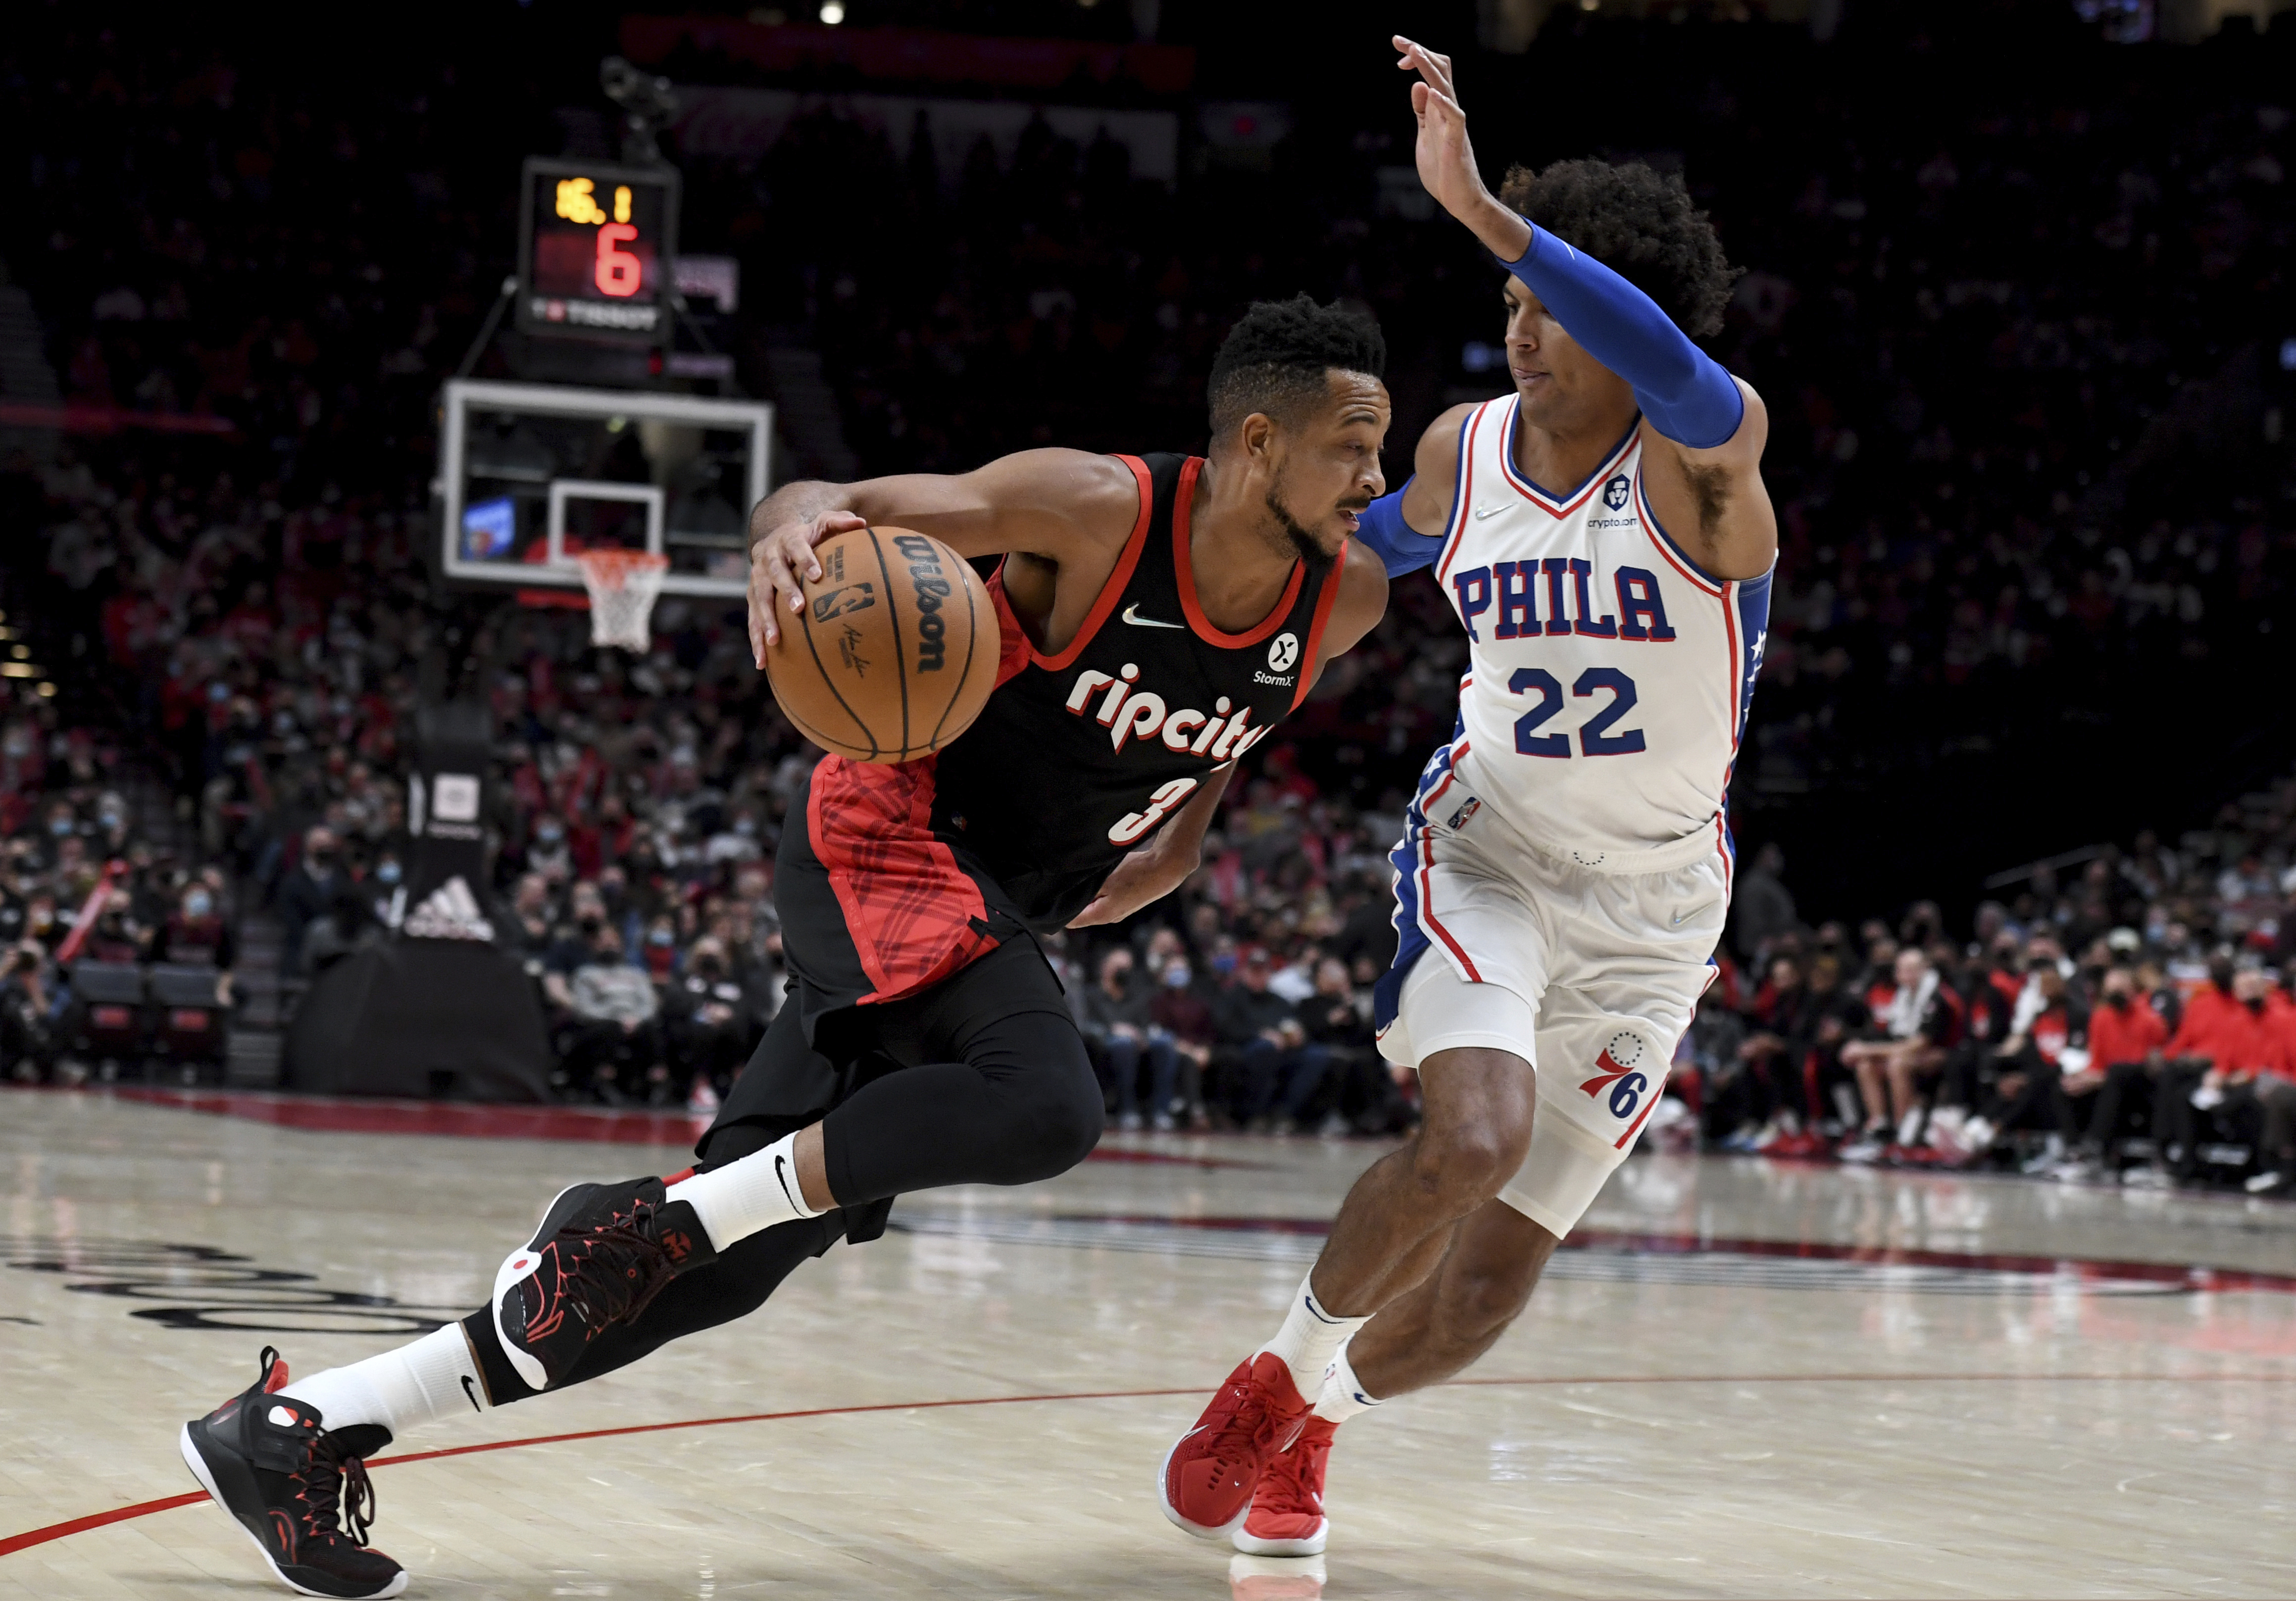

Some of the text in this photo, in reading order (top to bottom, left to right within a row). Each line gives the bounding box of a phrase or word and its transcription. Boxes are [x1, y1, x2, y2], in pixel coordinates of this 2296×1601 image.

[596, 223, 641, 296] 6
[1453, 558, 1676, 643] PHILA
[1253, 671, 1295, 686] StormX
[1508, 668, 1646, 759] 22
[1108, 778, 1197, 846] 3
